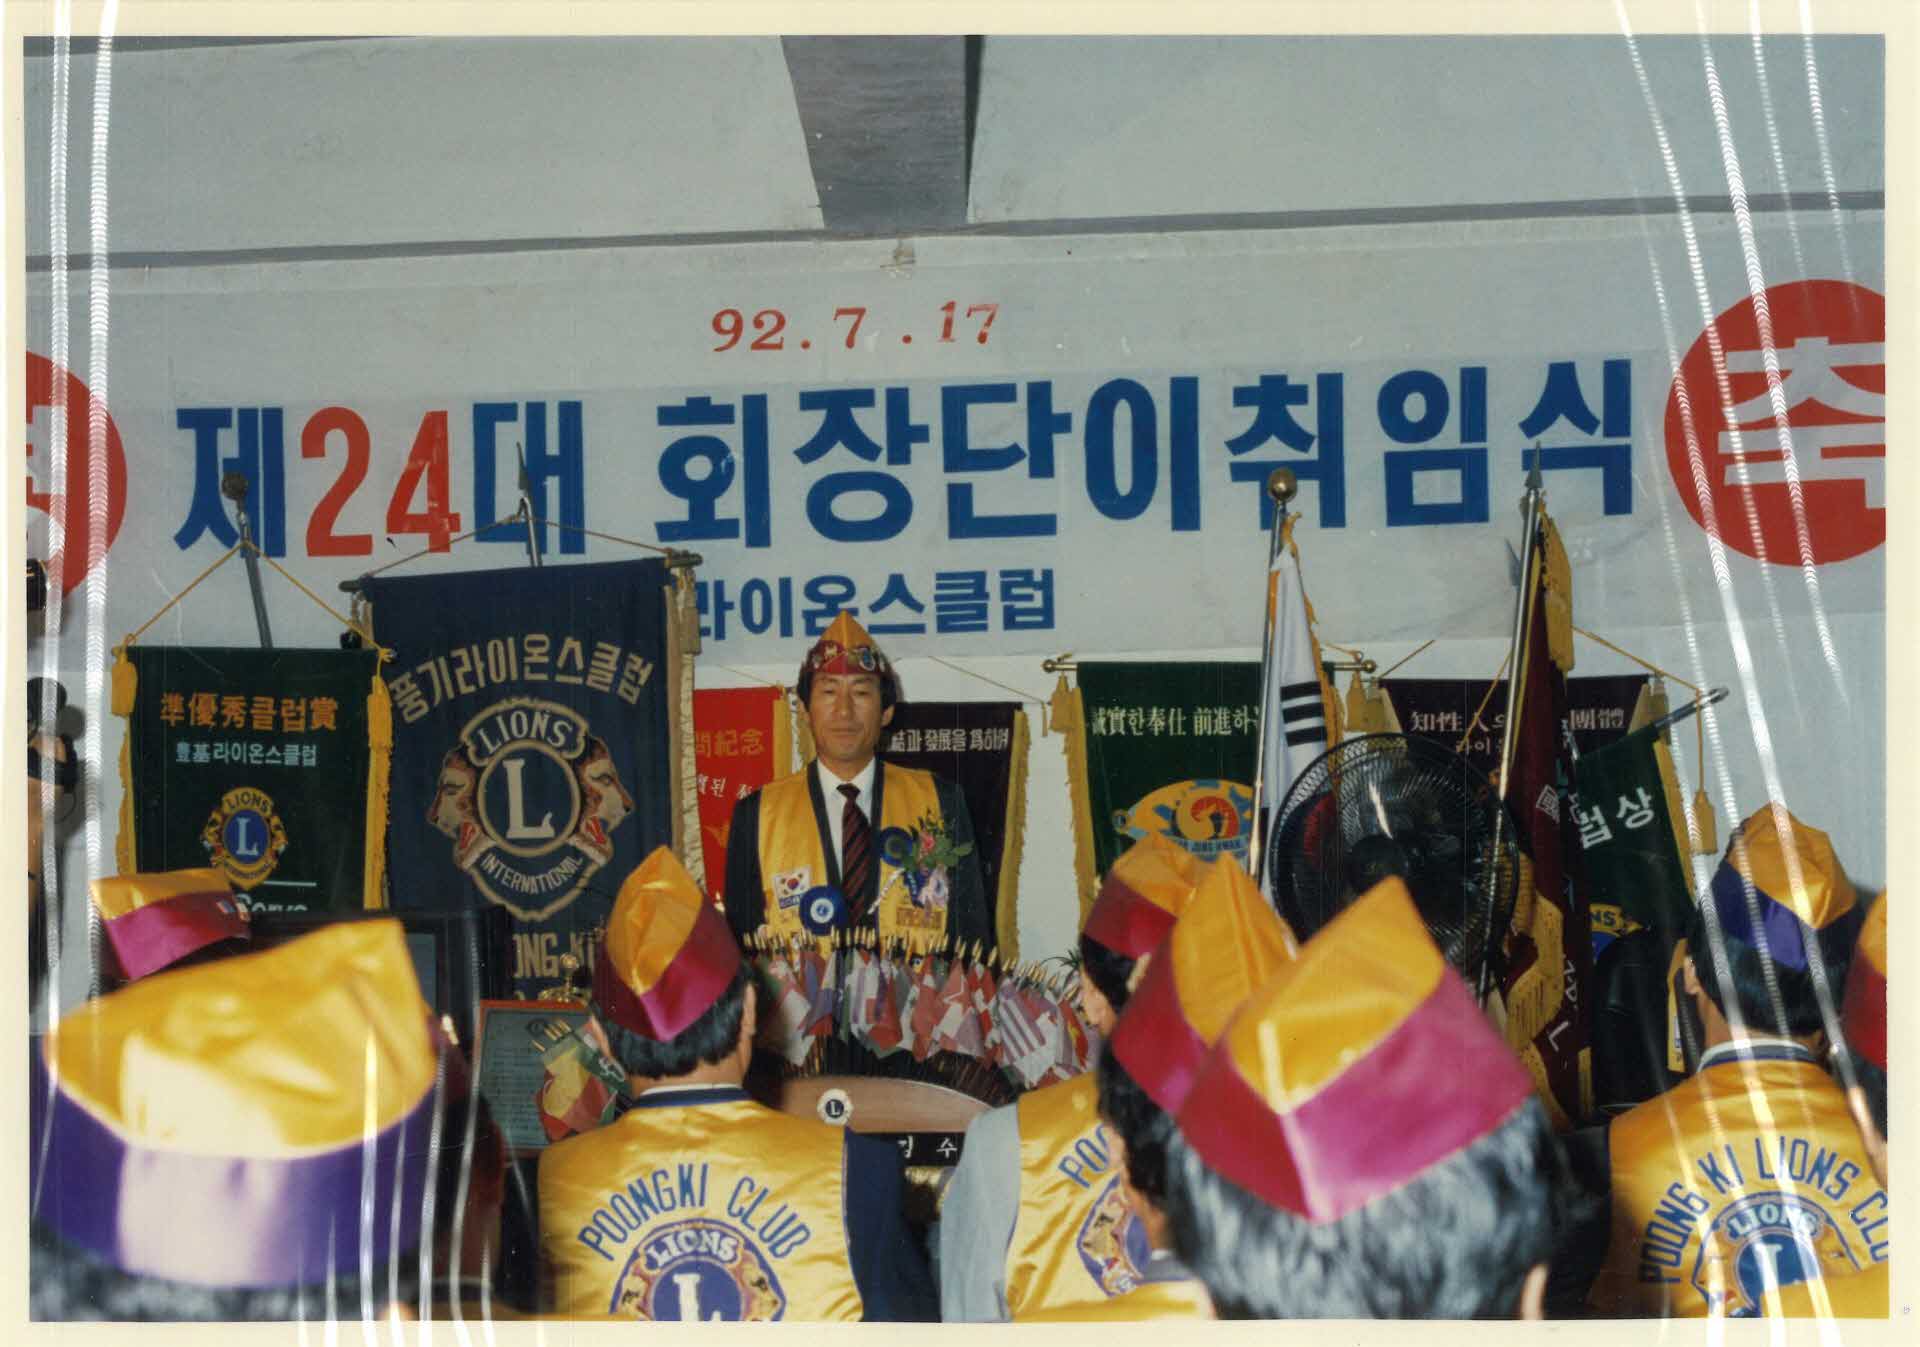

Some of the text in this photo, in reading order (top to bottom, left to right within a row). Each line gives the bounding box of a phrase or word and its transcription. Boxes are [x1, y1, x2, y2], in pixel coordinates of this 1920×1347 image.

[173, 400, 586, 559] 제24대
[388, 633, 653, 724] 풍기라이온스클럽
[479, 709, 573, 755] LIONS
[227, 791, 270, 813] LIONS
[502, 759, 555, 839] L
[1617, 787, 1654, 829] 상
[235, 816, 259, 856] L
[481, 852, 584, 895] INTERNATIONAL
[1697, 1143, 1744, 1195] KI
[1755, 1135, 1861, 1200] LIONS
[577, 1162, 811, 1262] POONGKI CLUB
[644, 1229, 739, 1267] LIONS
